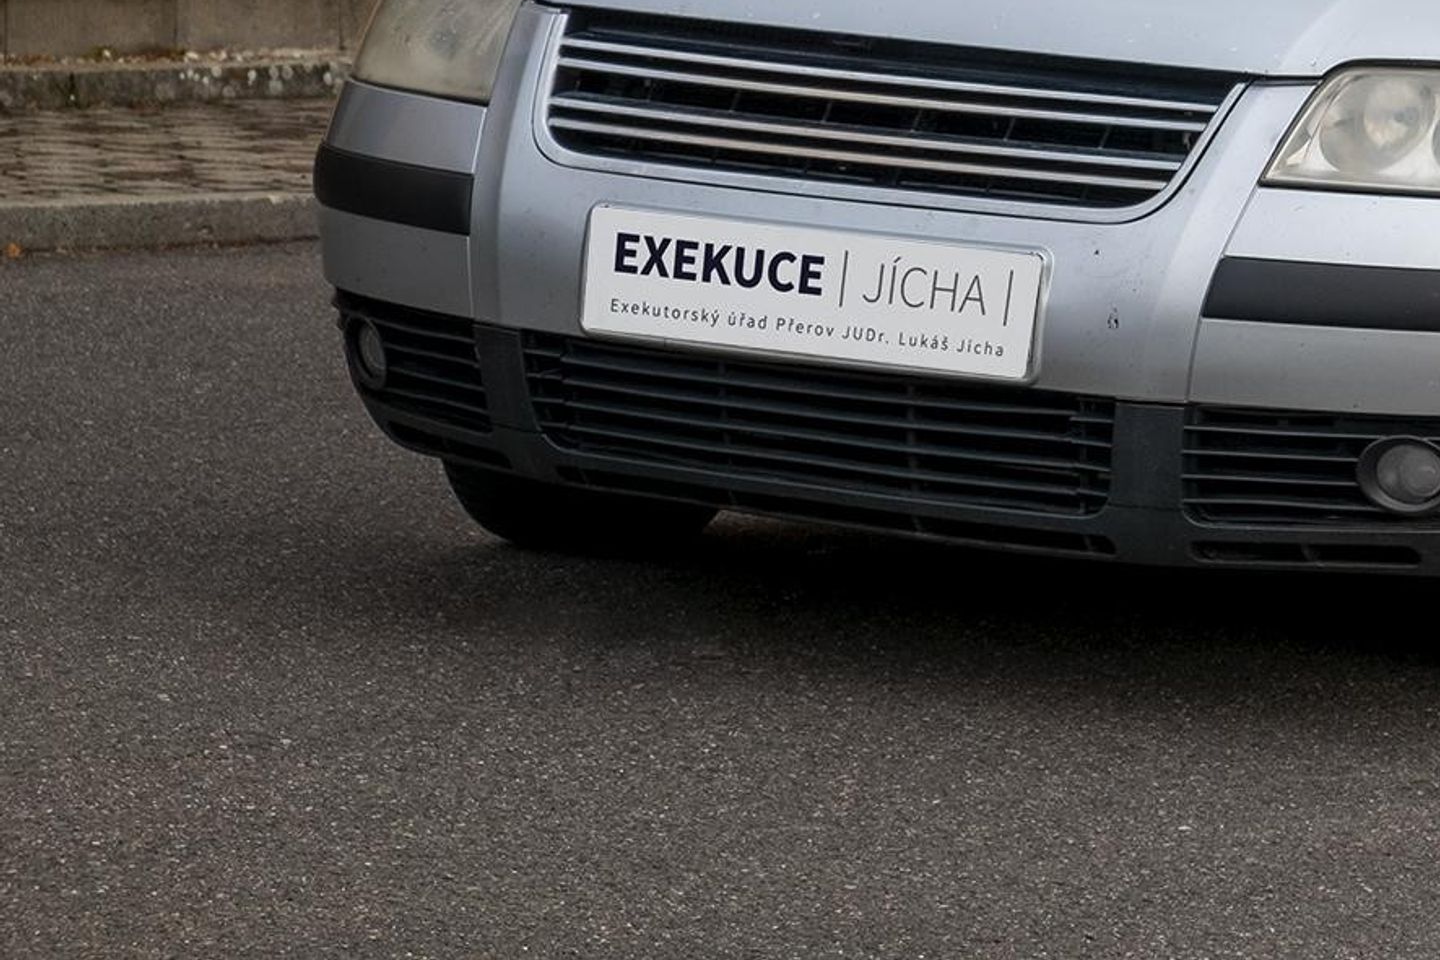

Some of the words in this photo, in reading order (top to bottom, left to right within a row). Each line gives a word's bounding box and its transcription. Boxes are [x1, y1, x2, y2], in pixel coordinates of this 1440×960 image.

[613, 231, 826, 297] EXEKUCE
[862, 256, 986, 316] JÍCHA
[610, 297, 720, 328] Exekutorský
[727, 311, 768, 330] úřad
[775, 317, 835, 337] Přerov
[841, 326, 889, 344] JUDr.
[897, 331, 949, 352] Lukáš
